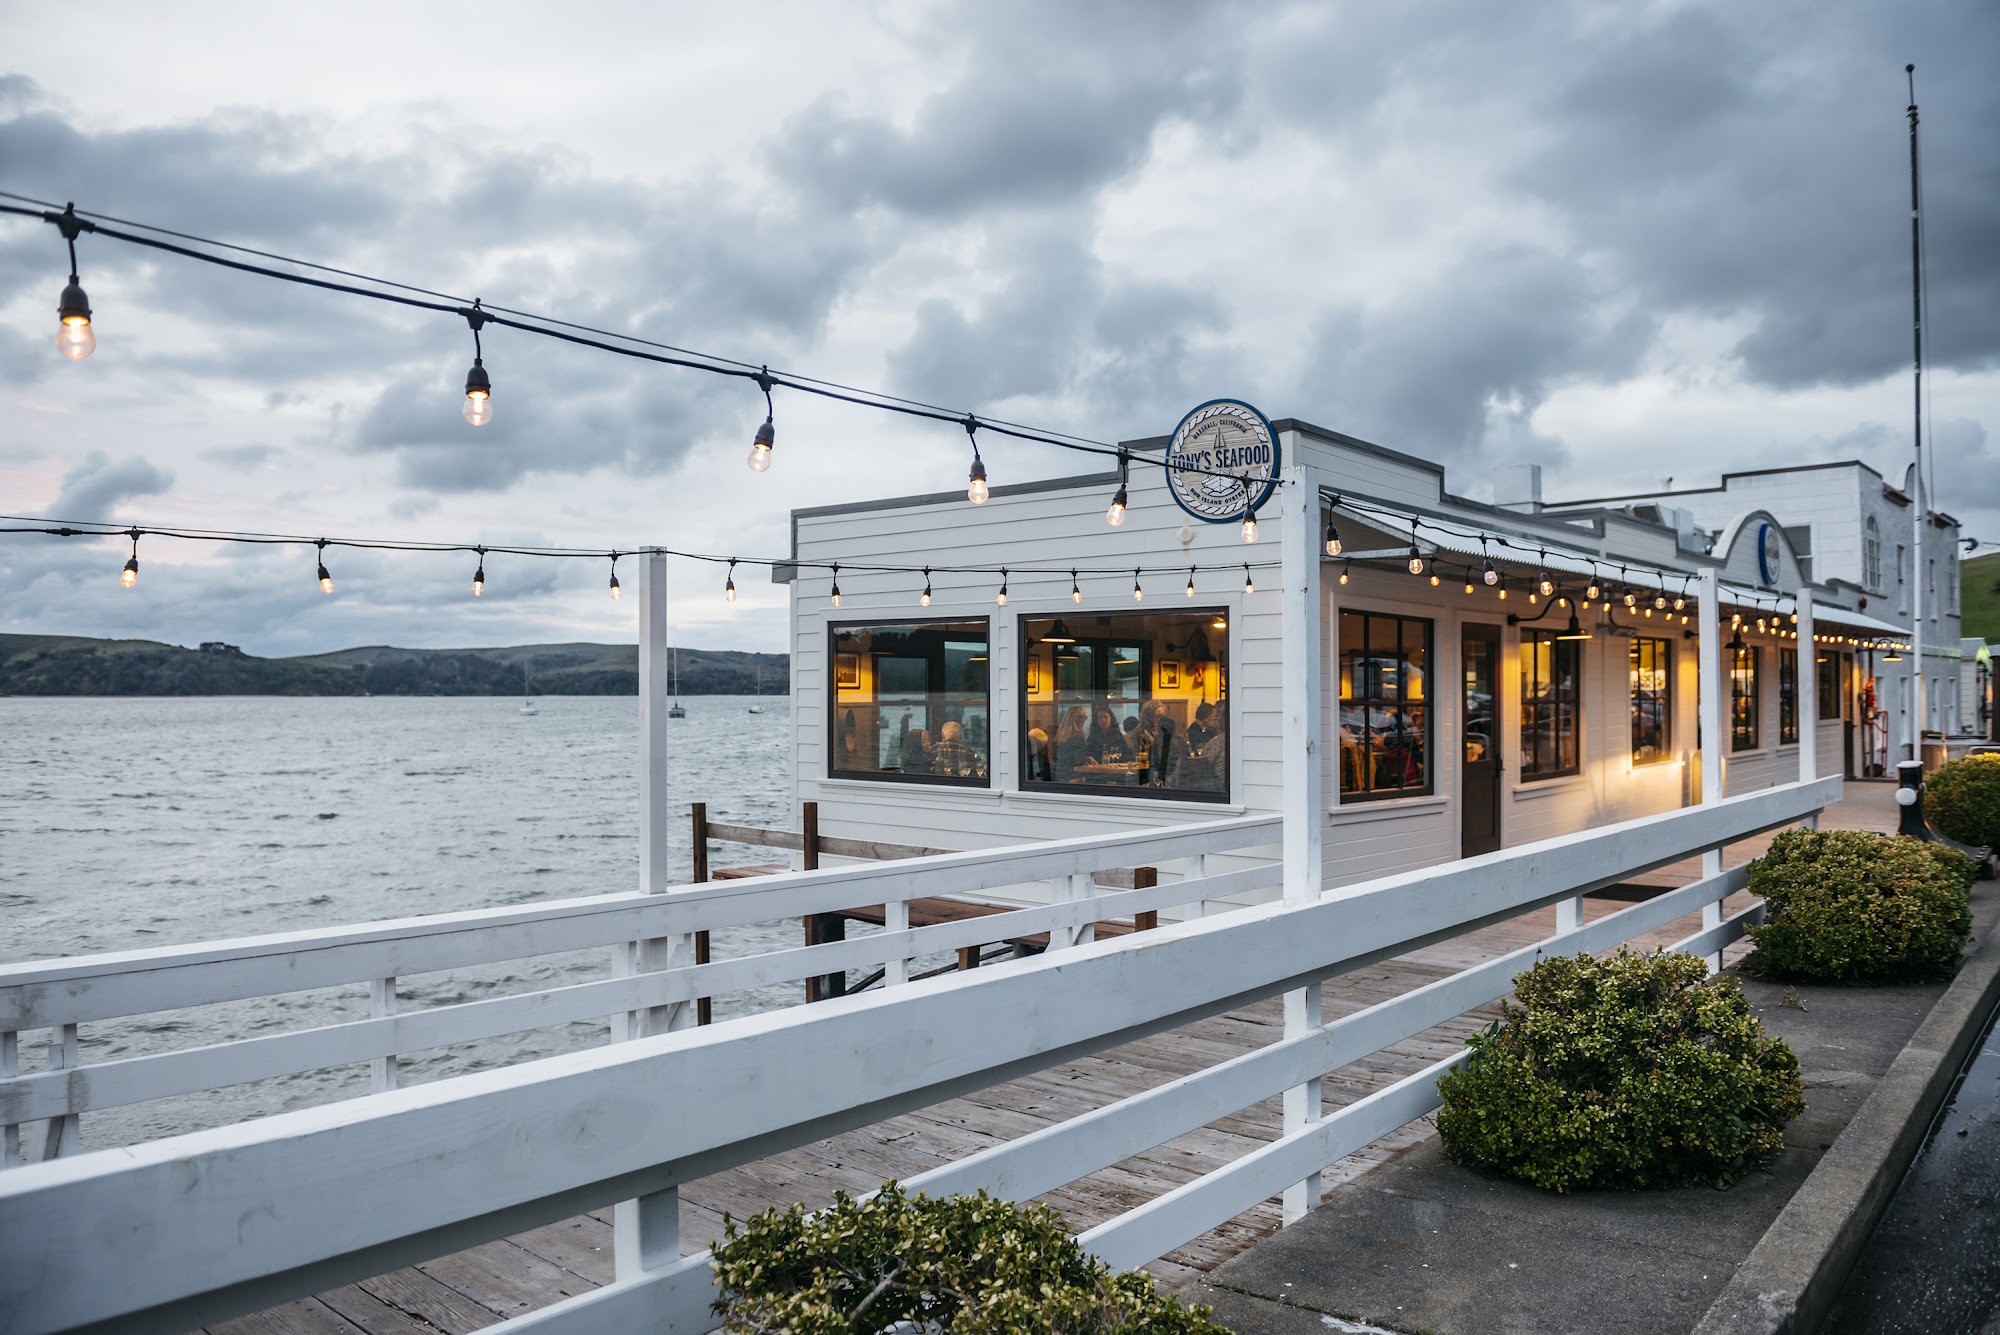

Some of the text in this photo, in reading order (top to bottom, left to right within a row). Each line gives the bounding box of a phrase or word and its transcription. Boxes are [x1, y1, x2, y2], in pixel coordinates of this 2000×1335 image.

[1220, 419, 1247, 434] CALIFORNIA
[1171, 444, 1270, 474] TONY'S SEAFOOD
[1201, 496, 1222, 505] ISLAND
